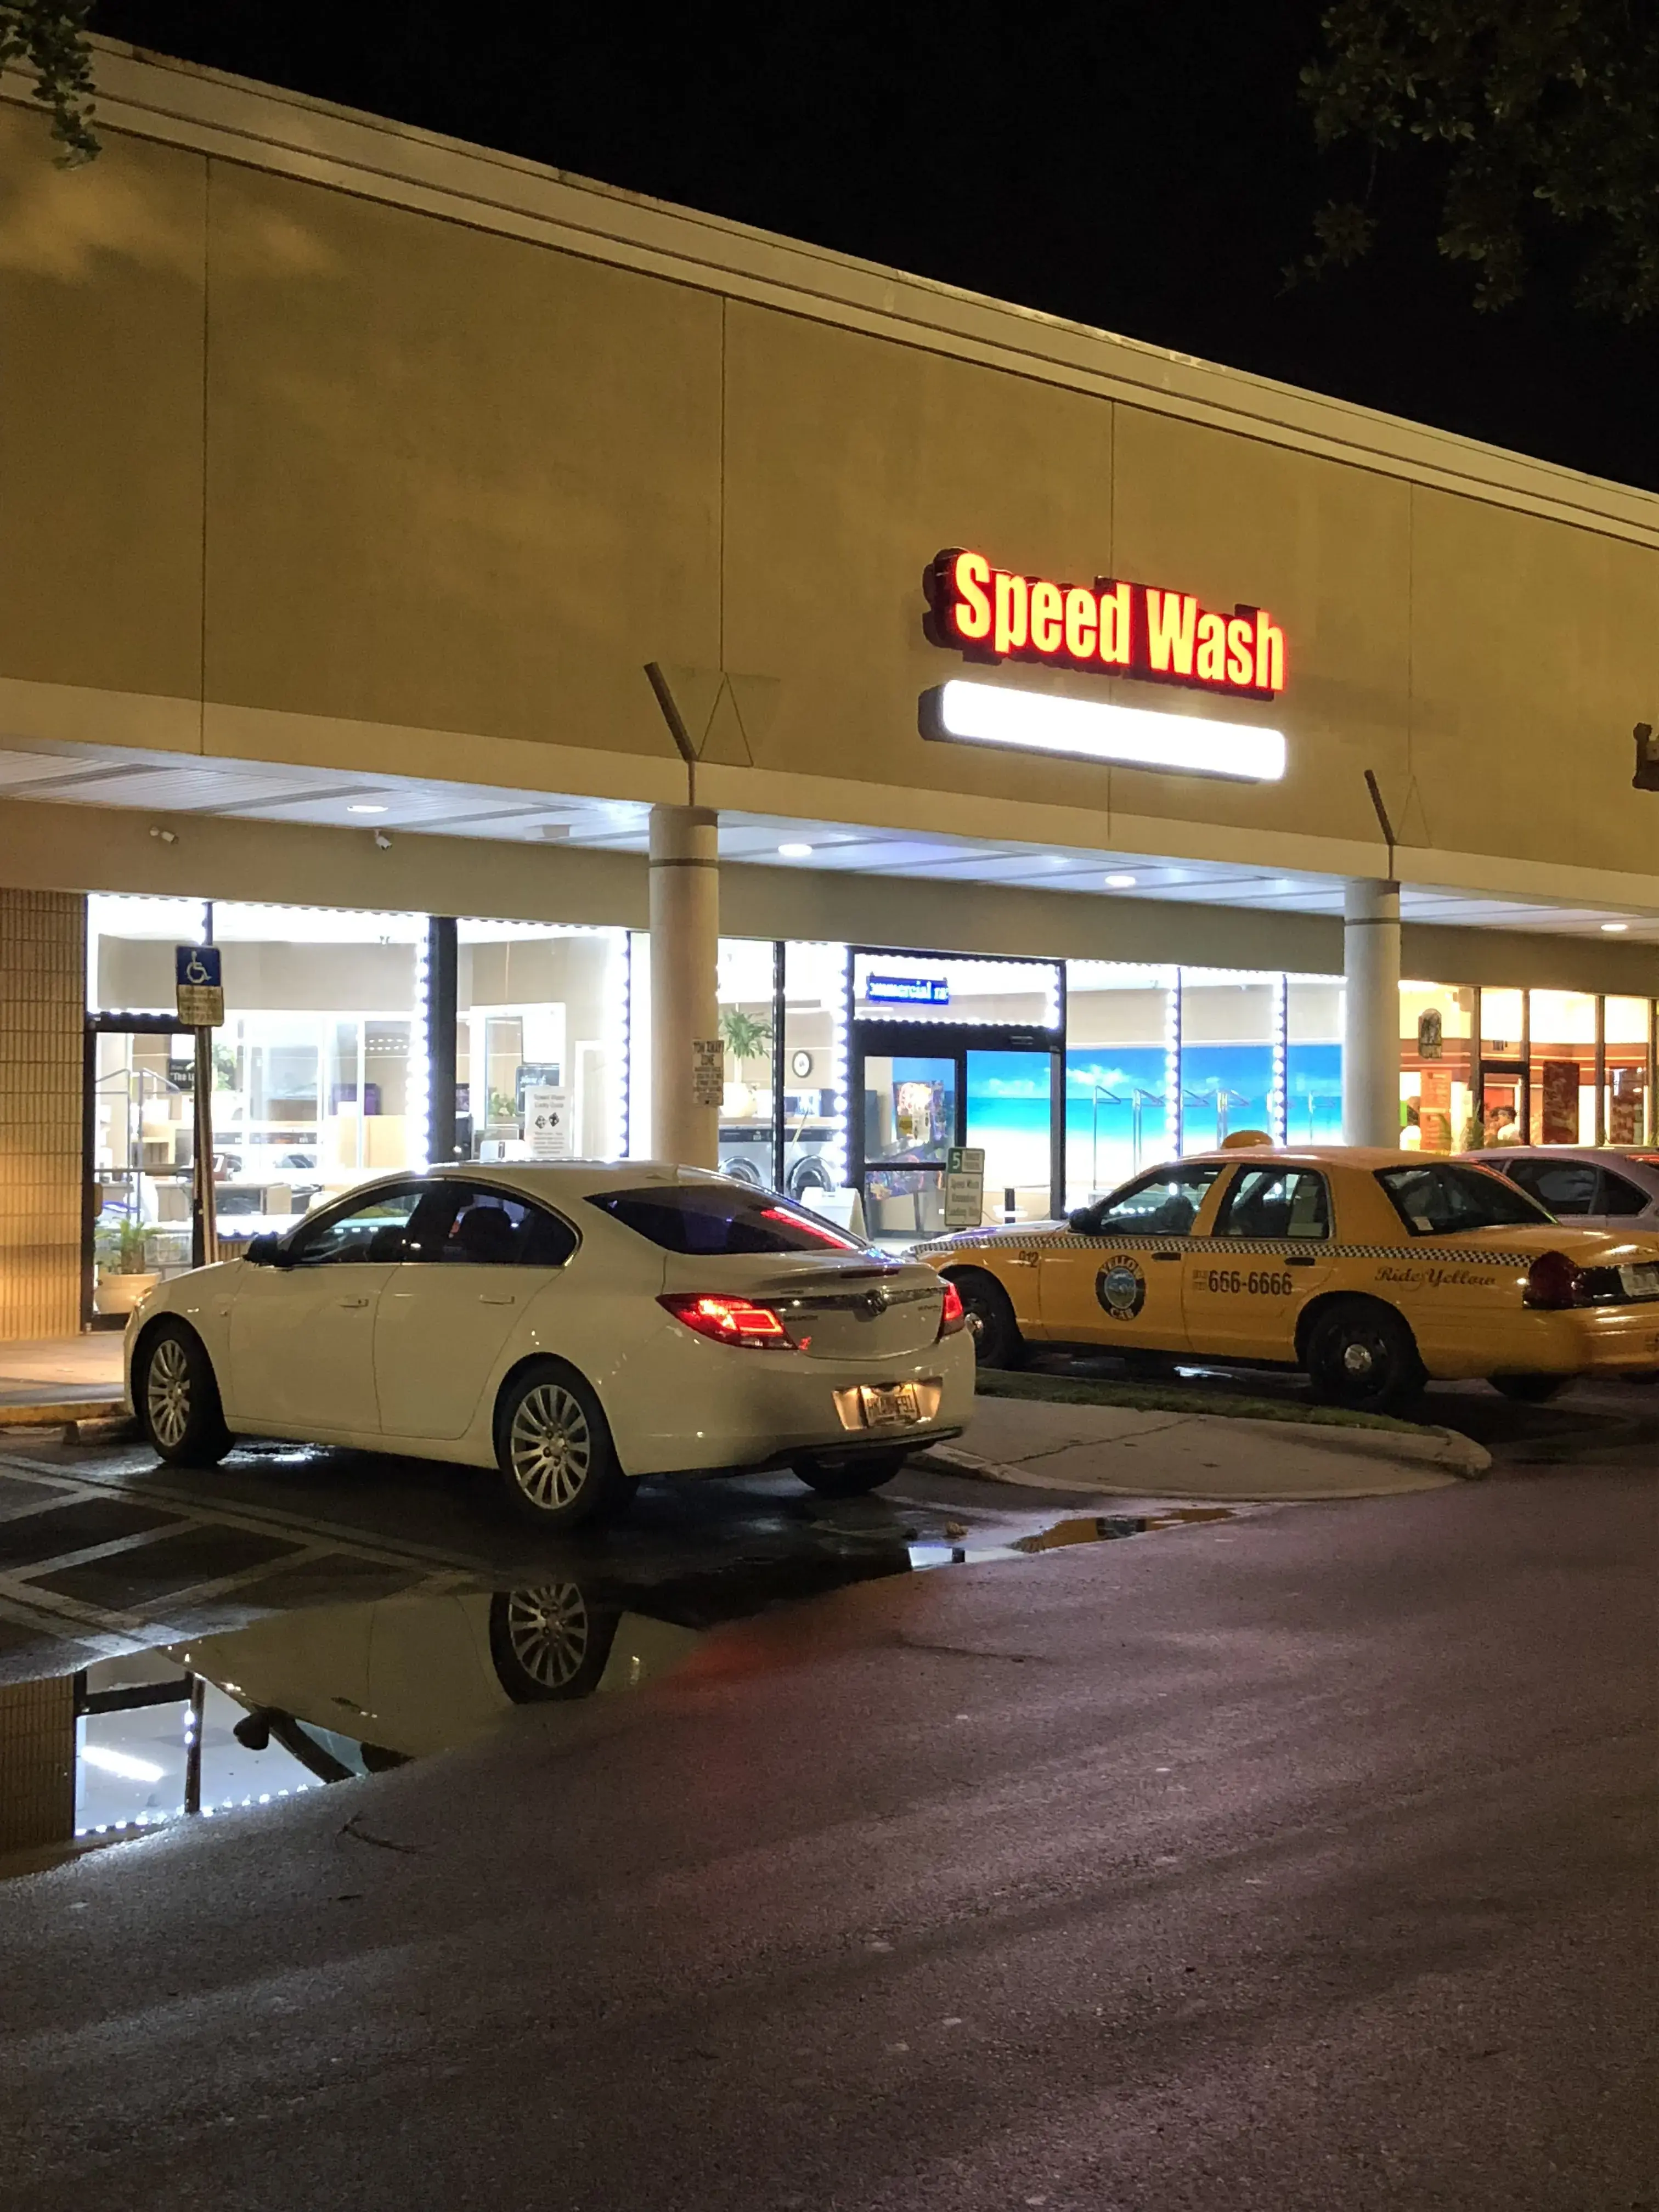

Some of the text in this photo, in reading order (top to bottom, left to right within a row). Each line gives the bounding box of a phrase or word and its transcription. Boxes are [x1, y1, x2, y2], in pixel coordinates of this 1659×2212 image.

[955, 552, 1285, 691] Speed Wash
[952, 1152, 961, 1170] 5
[1099, 1255, 1145, 1279] YELLOW
[1374, 1266, 1497, 1288] Ride Yellow
[1209, 1269, 1293, 1296] 666-6666
[1110, 1307, 1134, 1320] CAB
